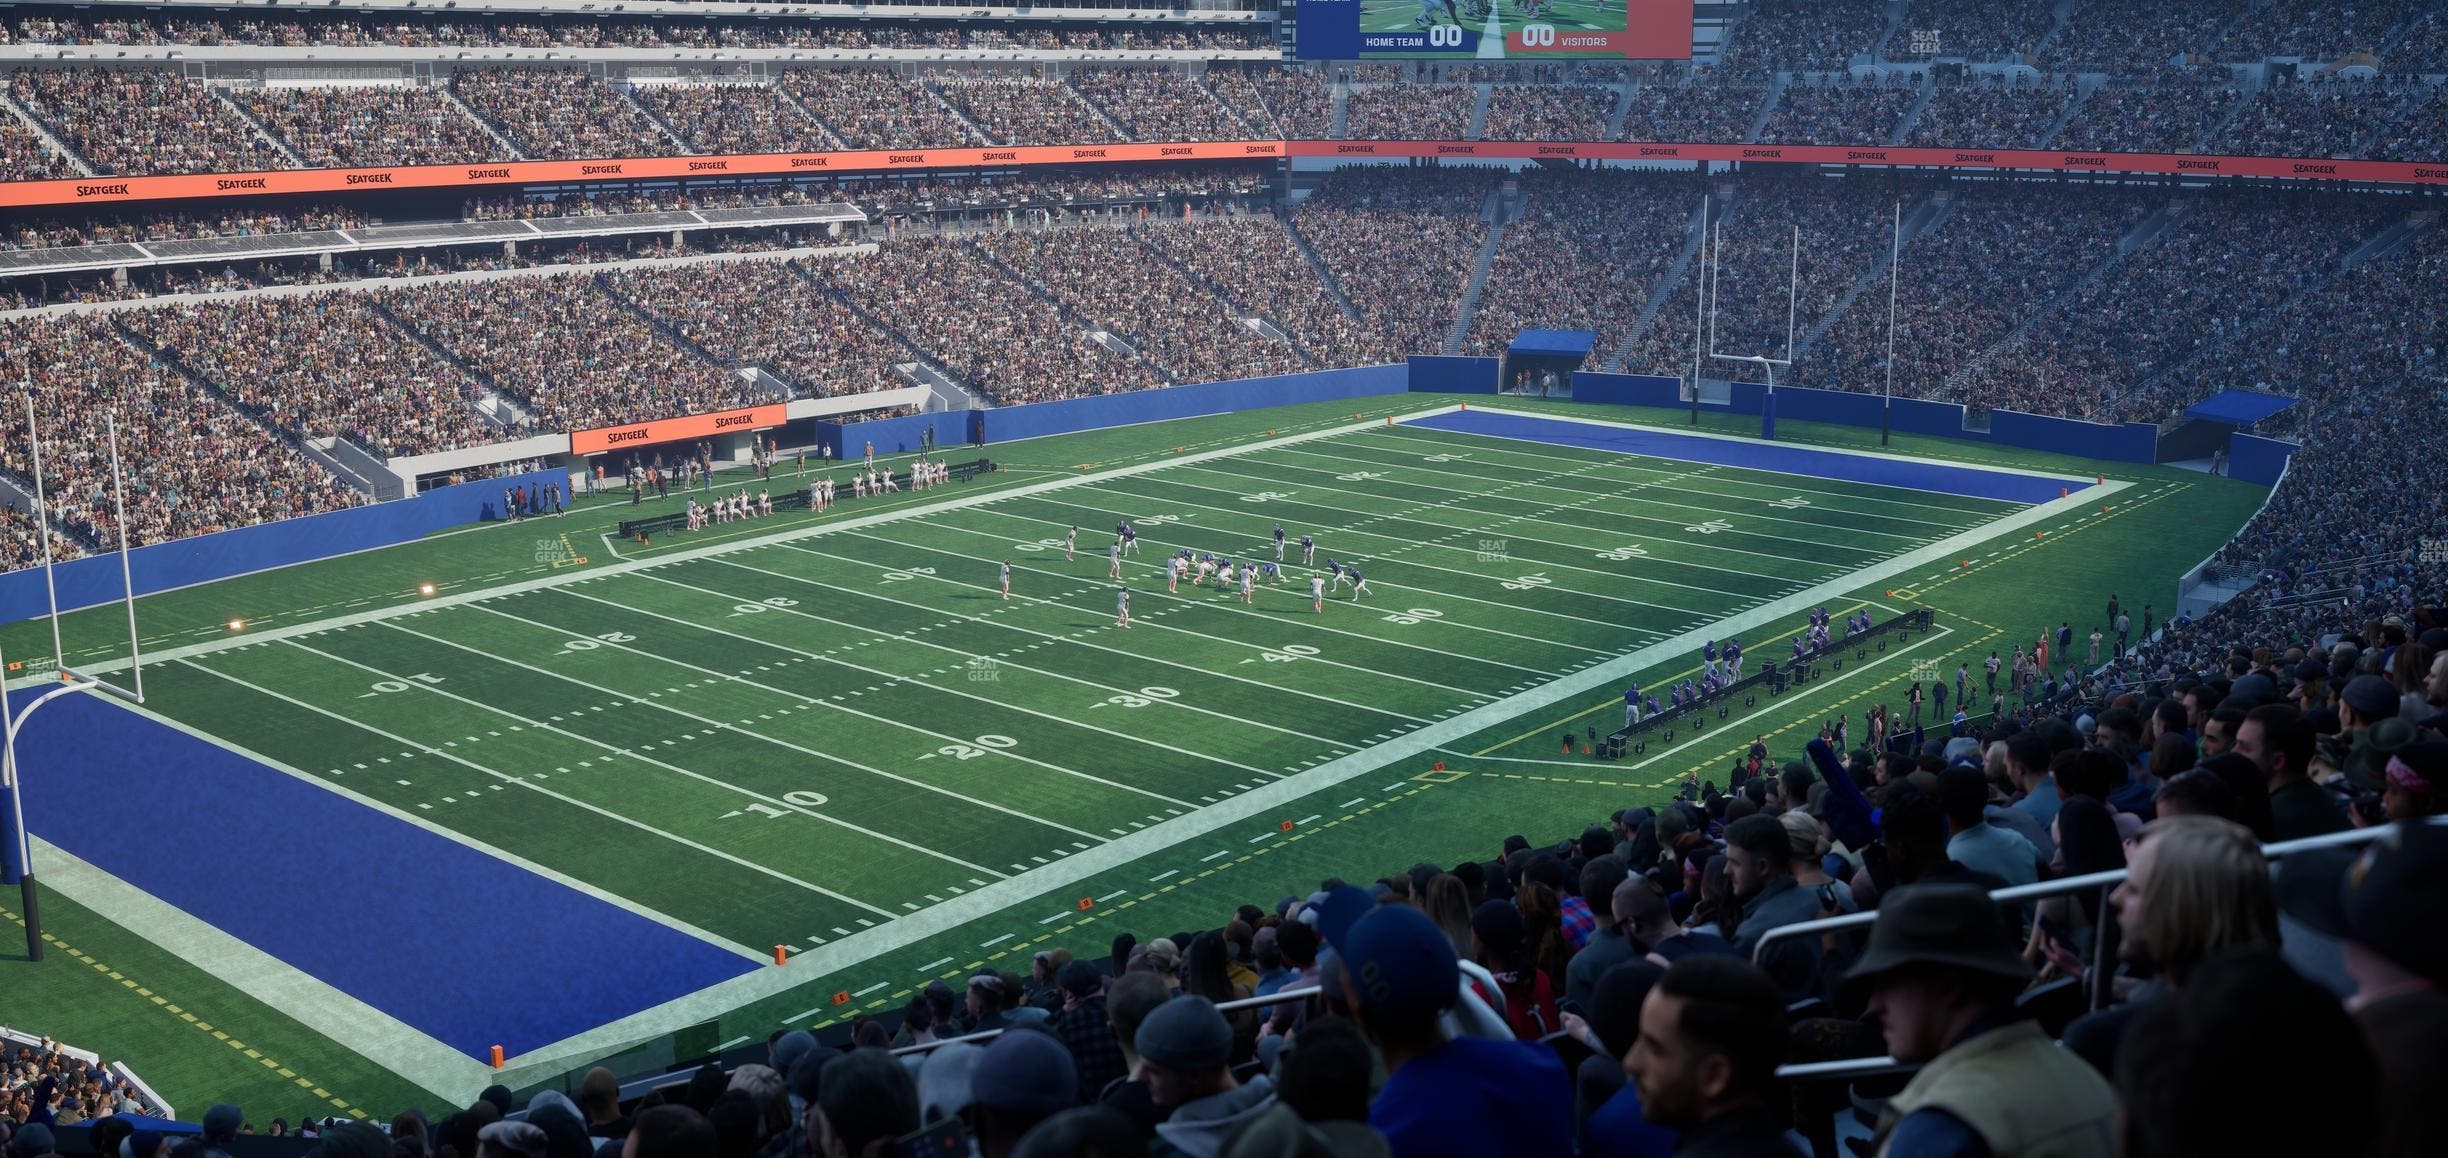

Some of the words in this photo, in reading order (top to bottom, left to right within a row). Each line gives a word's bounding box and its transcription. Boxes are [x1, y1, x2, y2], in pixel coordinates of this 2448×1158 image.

[1366, 37, 1394, 47] HOME
[1396, 37, 1424, 47] TEAM
[1430, 24, 1464, 47] 00
[1522, 24, 1555, 47] 00
[1561, 37, 1608, 47] VISITORS
[1073, 149, 1106, 159] SEATGEEK
[1160, 147, 1193, 156] SEATGEEK
[1246, 145, 1276, 154] SEATGEEK
[1337, 144, 1375, 153] SEATGEEK
[1438, 145, 1474, 154] SEATGEEK
[1538, 146, 1575, 155] SEATGEEK
[1640, 147, 1678, 157] SEATGEEK
[1743, 149, 1782, 158] SEATGEEK
[888, 154, 925, 165] SEATGEEK
[982, 151, 1016, 162] SEATGEEK
[1847, 151, 1887, 161] SEATGEEK
[1955, 153, 1995, 163] SEATGEEK
[2064, 156, 2106, 167] SEATGEEK
[688, 160, 728, 171] SEATGEEK
[791, 157, 828, 168] SEATGEEK
[2177, 159, 2220, 171] SEATGEEK
[468, 168, 511, 180] SEATGEEK
[581, 164, 622, 176] SEATGEEK
[2292, 163, 2336, 175] SEATGEEK
[217, 178, 266, 191] SEATGEEK
[346, 173, 393, 185] SEATGEEK
[76, 183, 129, 197] SEATGEEK
[715, 413, 753, 429] SEATGEEK
[607, 428, 649, 444] SEATGEEK
[1133, 515, 1180, 525] 40
[1684, 521, 1734, 534] 20
[1595, 547, 1648, 561] 30
[882, 567, 936, 581] 40
[1500, 575, 1552, 590] 40
[733, 597, 799, 613] 30
[1380, 608, 1444, 625] 50
[564, 631, 637, 650] 20
[1260, 645, 1321, 664] 40
[371, 672, 446, 693] 10
[1108, 686, 1180, 708] 30
[938, 735, 1018, 760] 20
[745, 791, 828, 818] 10
